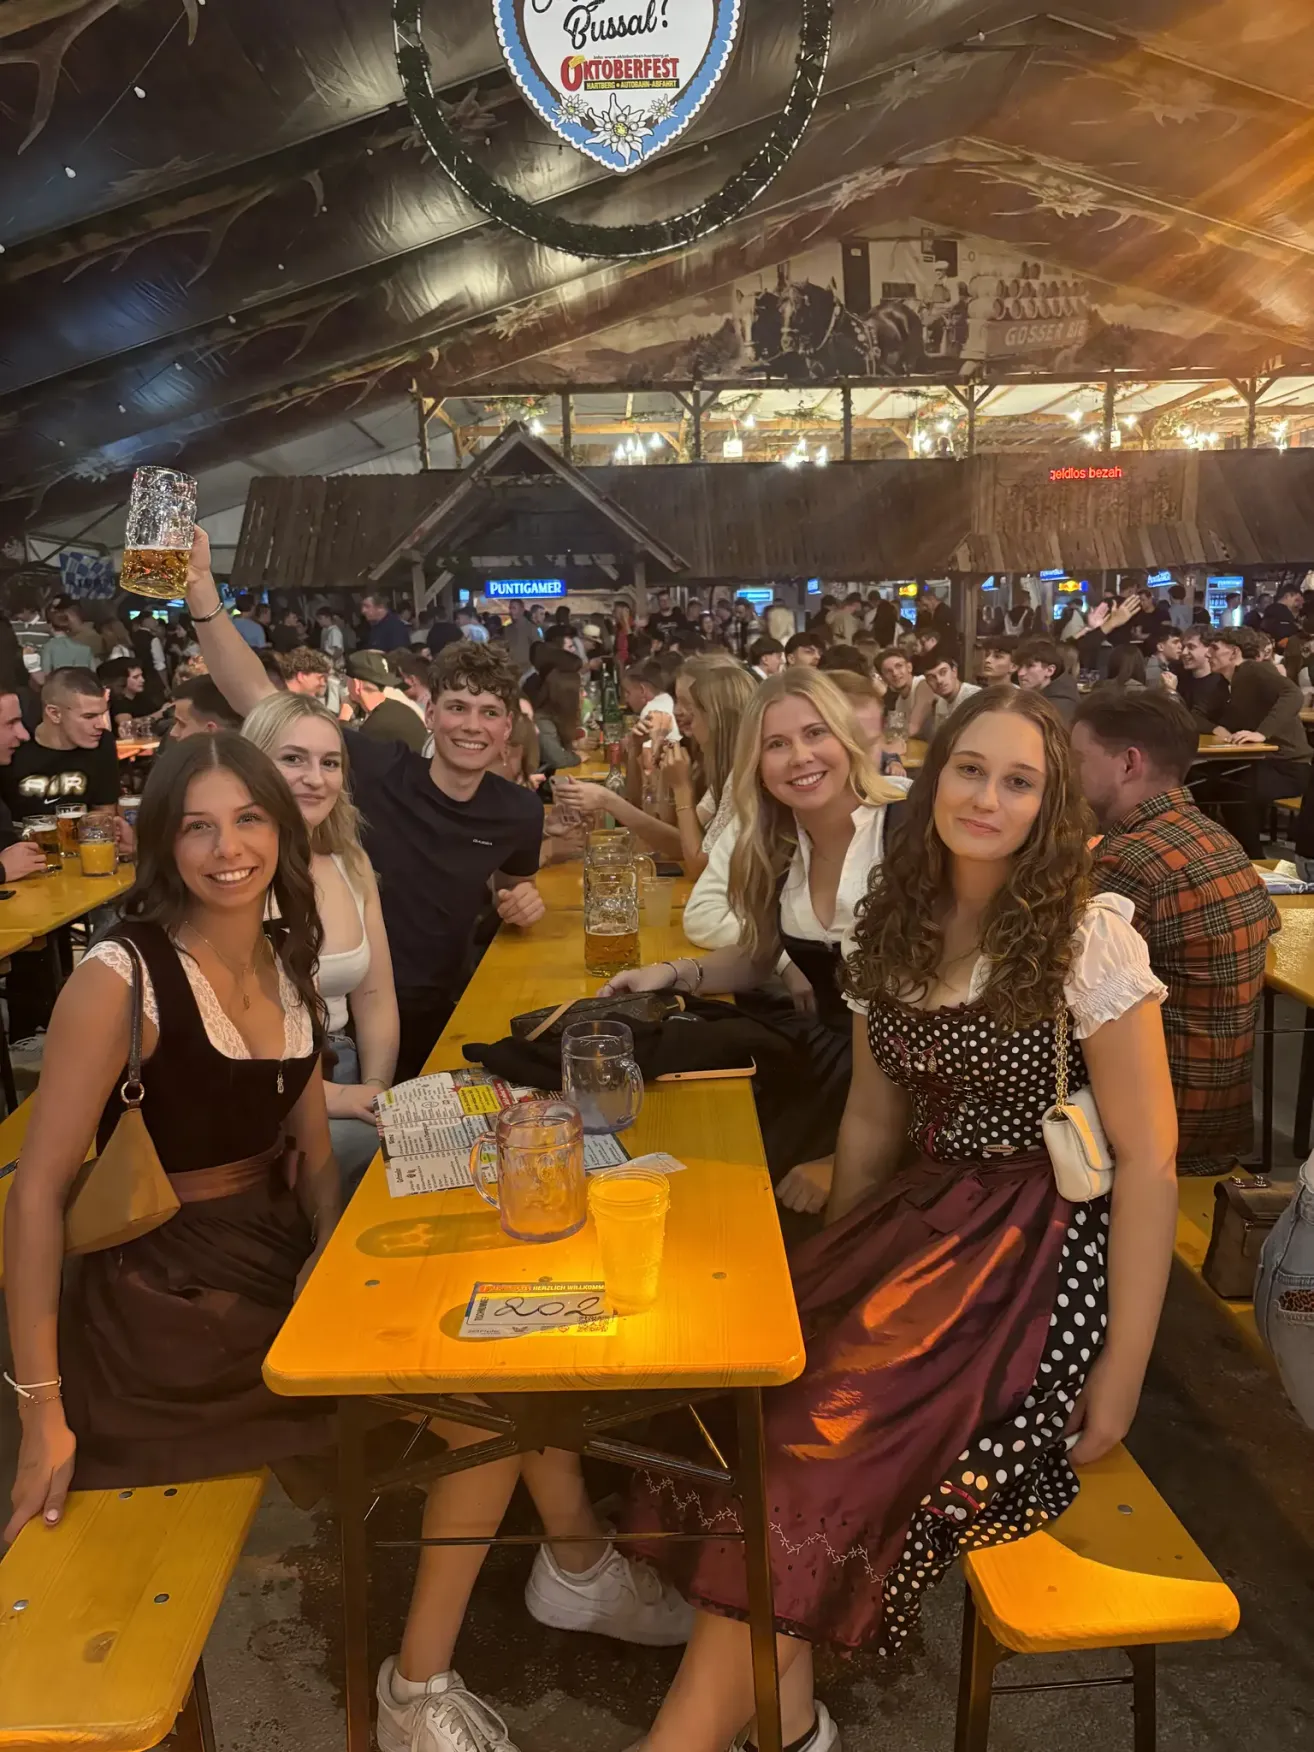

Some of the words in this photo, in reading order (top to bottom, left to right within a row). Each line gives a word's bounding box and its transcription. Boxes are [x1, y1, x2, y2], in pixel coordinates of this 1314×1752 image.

[560, 54, 679, 91] OKTOBERFEST
[586, 81, 615, 90] HARTBERG
[489, 580, 562, 595] PUNTIGAMER
[533, 1284, 566, 1292] HERZLICH
